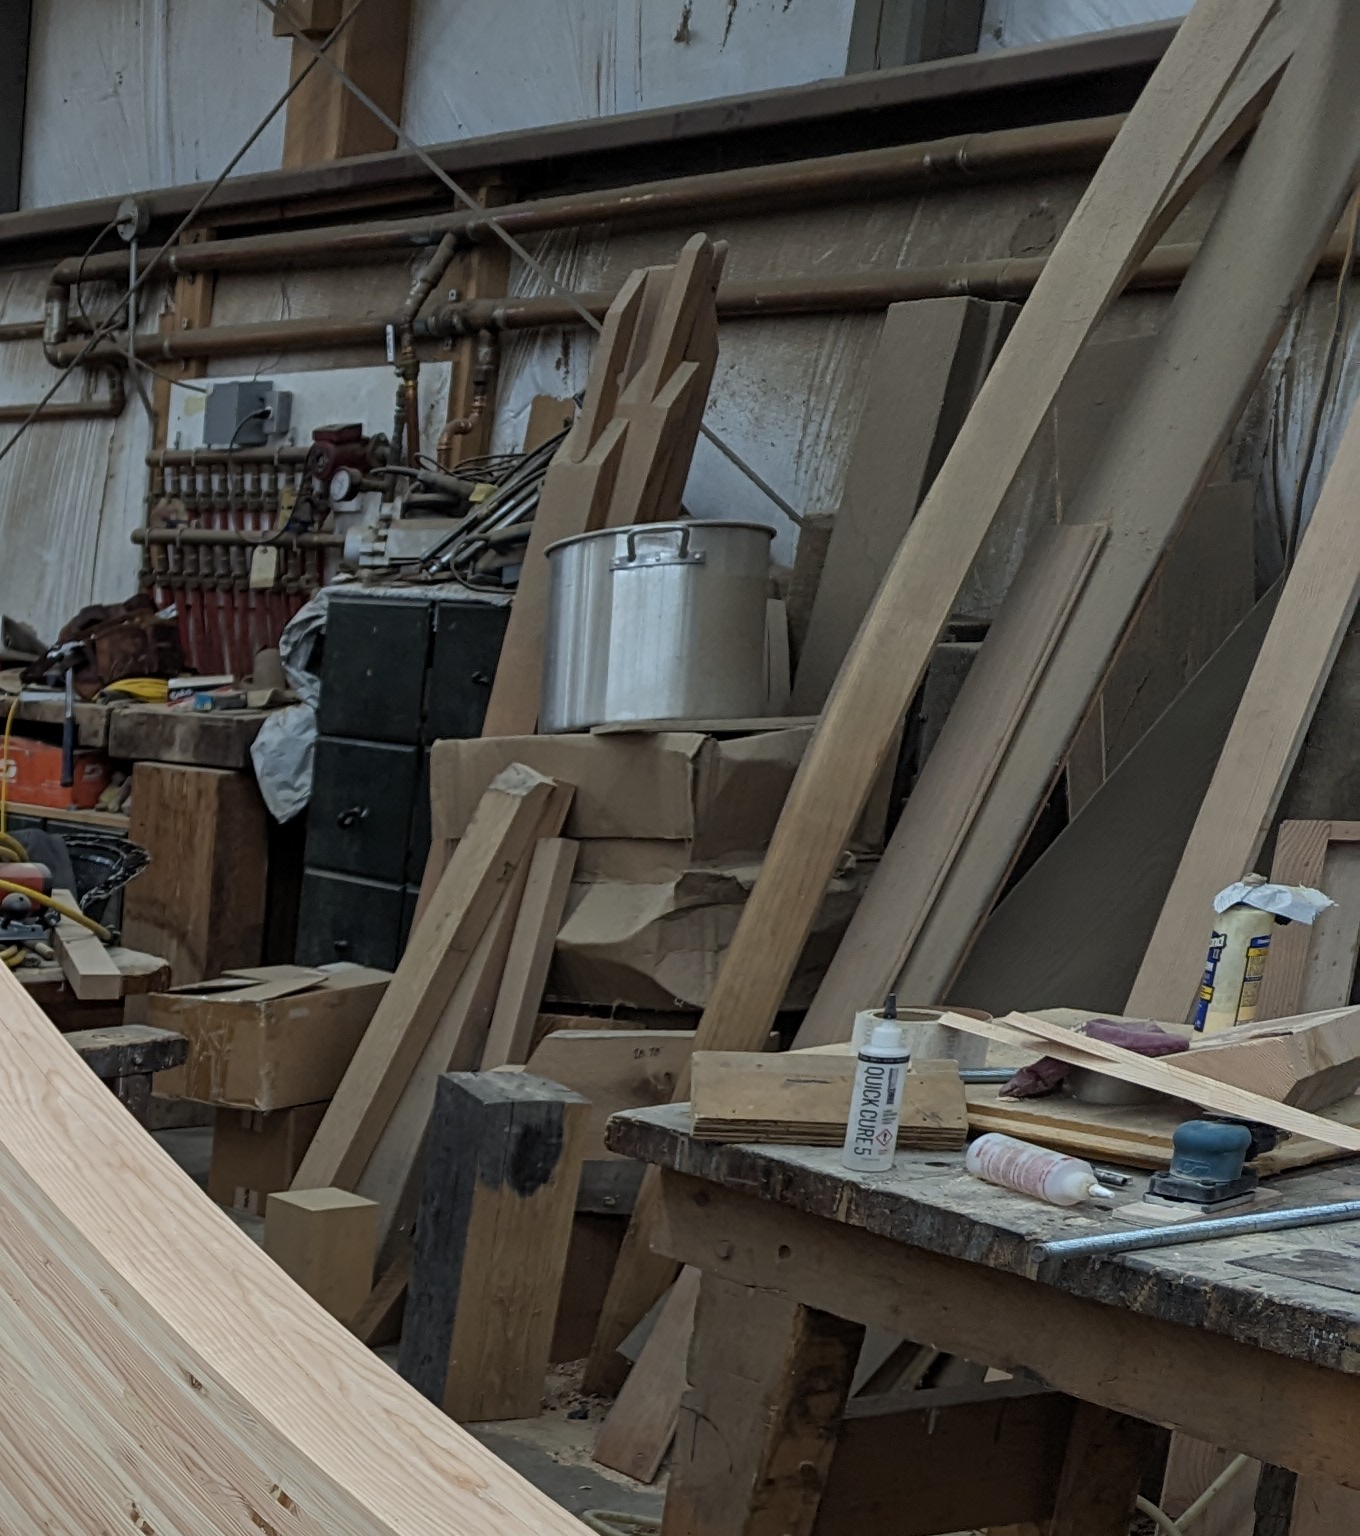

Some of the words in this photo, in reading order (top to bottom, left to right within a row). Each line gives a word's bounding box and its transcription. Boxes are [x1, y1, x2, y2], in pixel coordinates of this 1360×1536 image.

[860, 1066, 885, 1108] QUICK
[855, 1110, 878, 1145] CURE
[853, 1147, 872, 1156] 5
